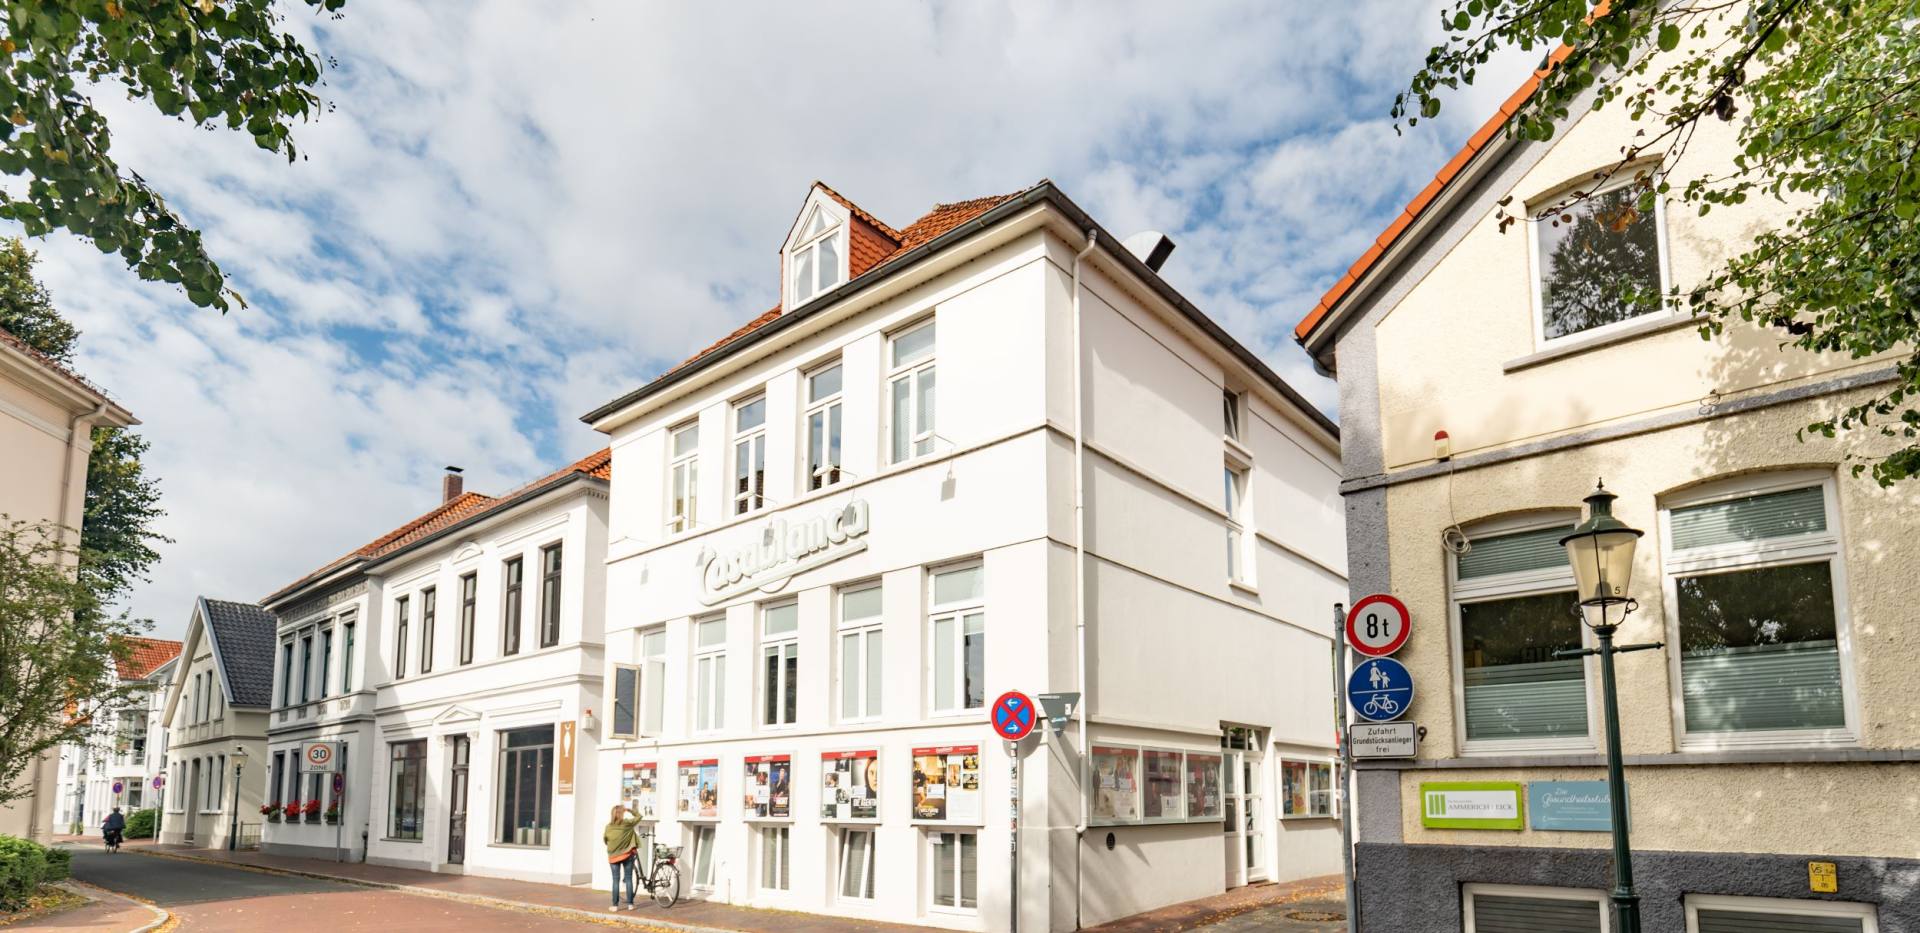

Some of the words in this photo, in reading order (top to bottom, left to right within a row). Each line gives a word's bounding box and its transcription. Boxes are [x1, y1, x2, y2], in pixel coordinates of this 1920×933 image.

[697, 498, 869, 606] Casablanca
[1614, 586, 1621, 595] 5
[1366, 613, 1378, 639] 8
[1382, 618, 1390, 637] t
[1353, 737, 1412, 745] Grundstücksanlieger
[1418, 726, 1428, 742] 9
[313, 749, 327, 759] 30
[1543, 792, 1611, 808] Gesundheitsstub
